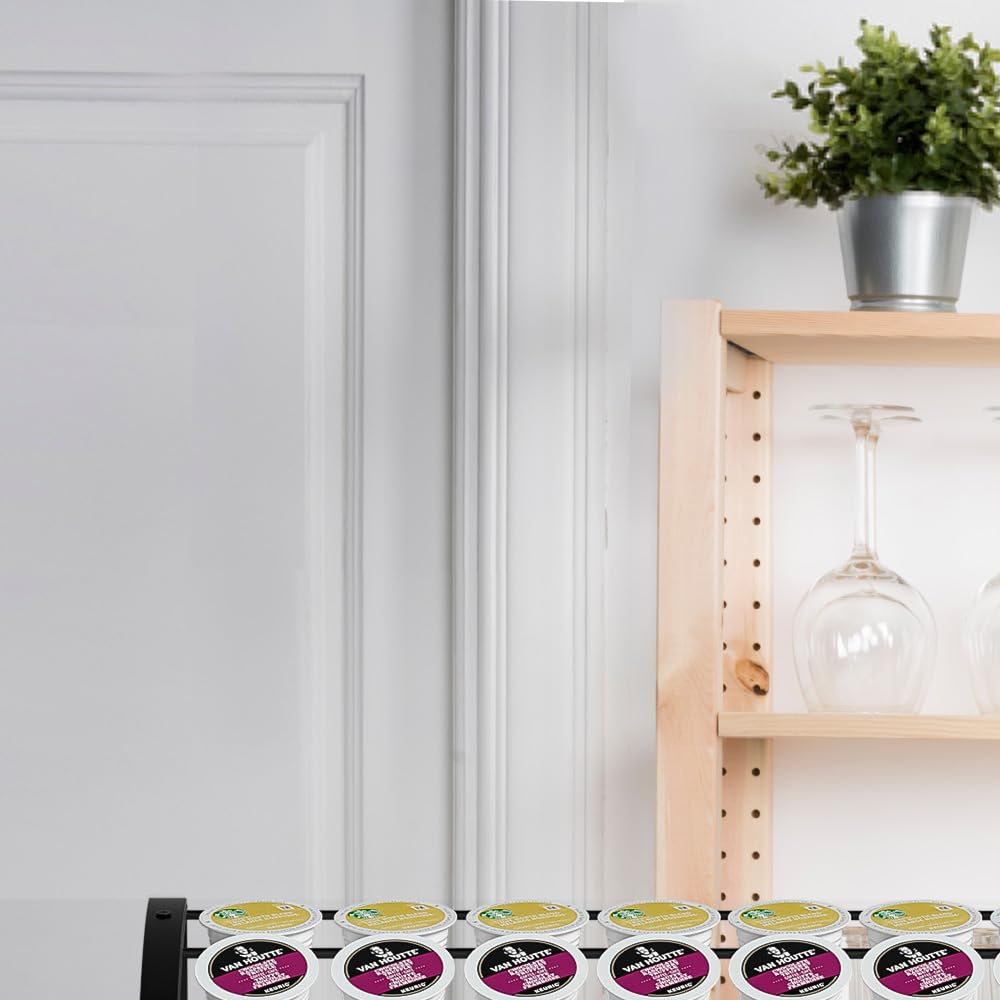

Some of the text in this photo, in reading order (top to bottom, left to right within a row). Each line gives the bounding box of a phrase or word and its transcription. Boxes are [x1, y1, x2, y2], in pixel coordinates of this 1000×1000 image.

[220, 949, 284, 972] VAN HOUTTE
[356, 949, 420, 972] VAN HOUTTE
[489, 949, 553, 972] VAN HOUTTE
[622, 949, 686, 972] VAN HOUTTE
[754, 949, 818, 972] VAN HOUTTE
[886, 949, 950, 972] VAN HOUTTE
